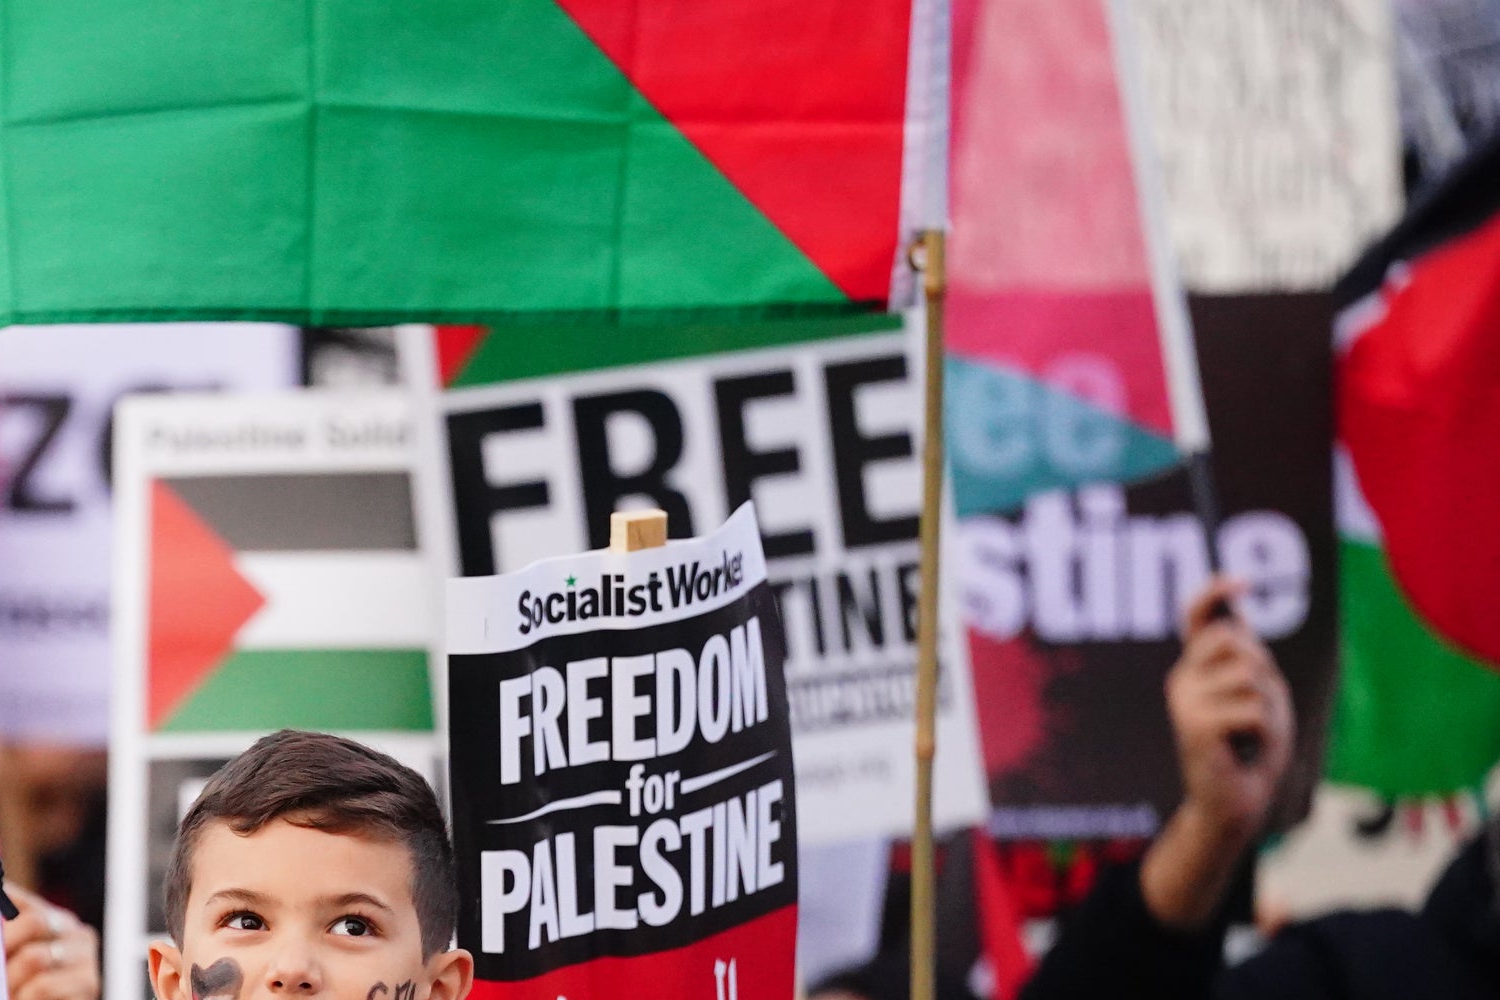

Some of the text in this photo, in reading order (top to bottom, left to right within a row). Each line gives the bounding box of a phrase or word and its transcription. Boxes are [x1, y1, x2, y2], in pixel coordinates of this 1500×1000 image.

[446, 354, 920, 577] FREE
[518, 549, 743, 635] Socialist Worker
[500, 617, 768, 785] FREEDOM
[481, 778, 785, 954] PALESTINE
[625, 763, 681, 817] for
